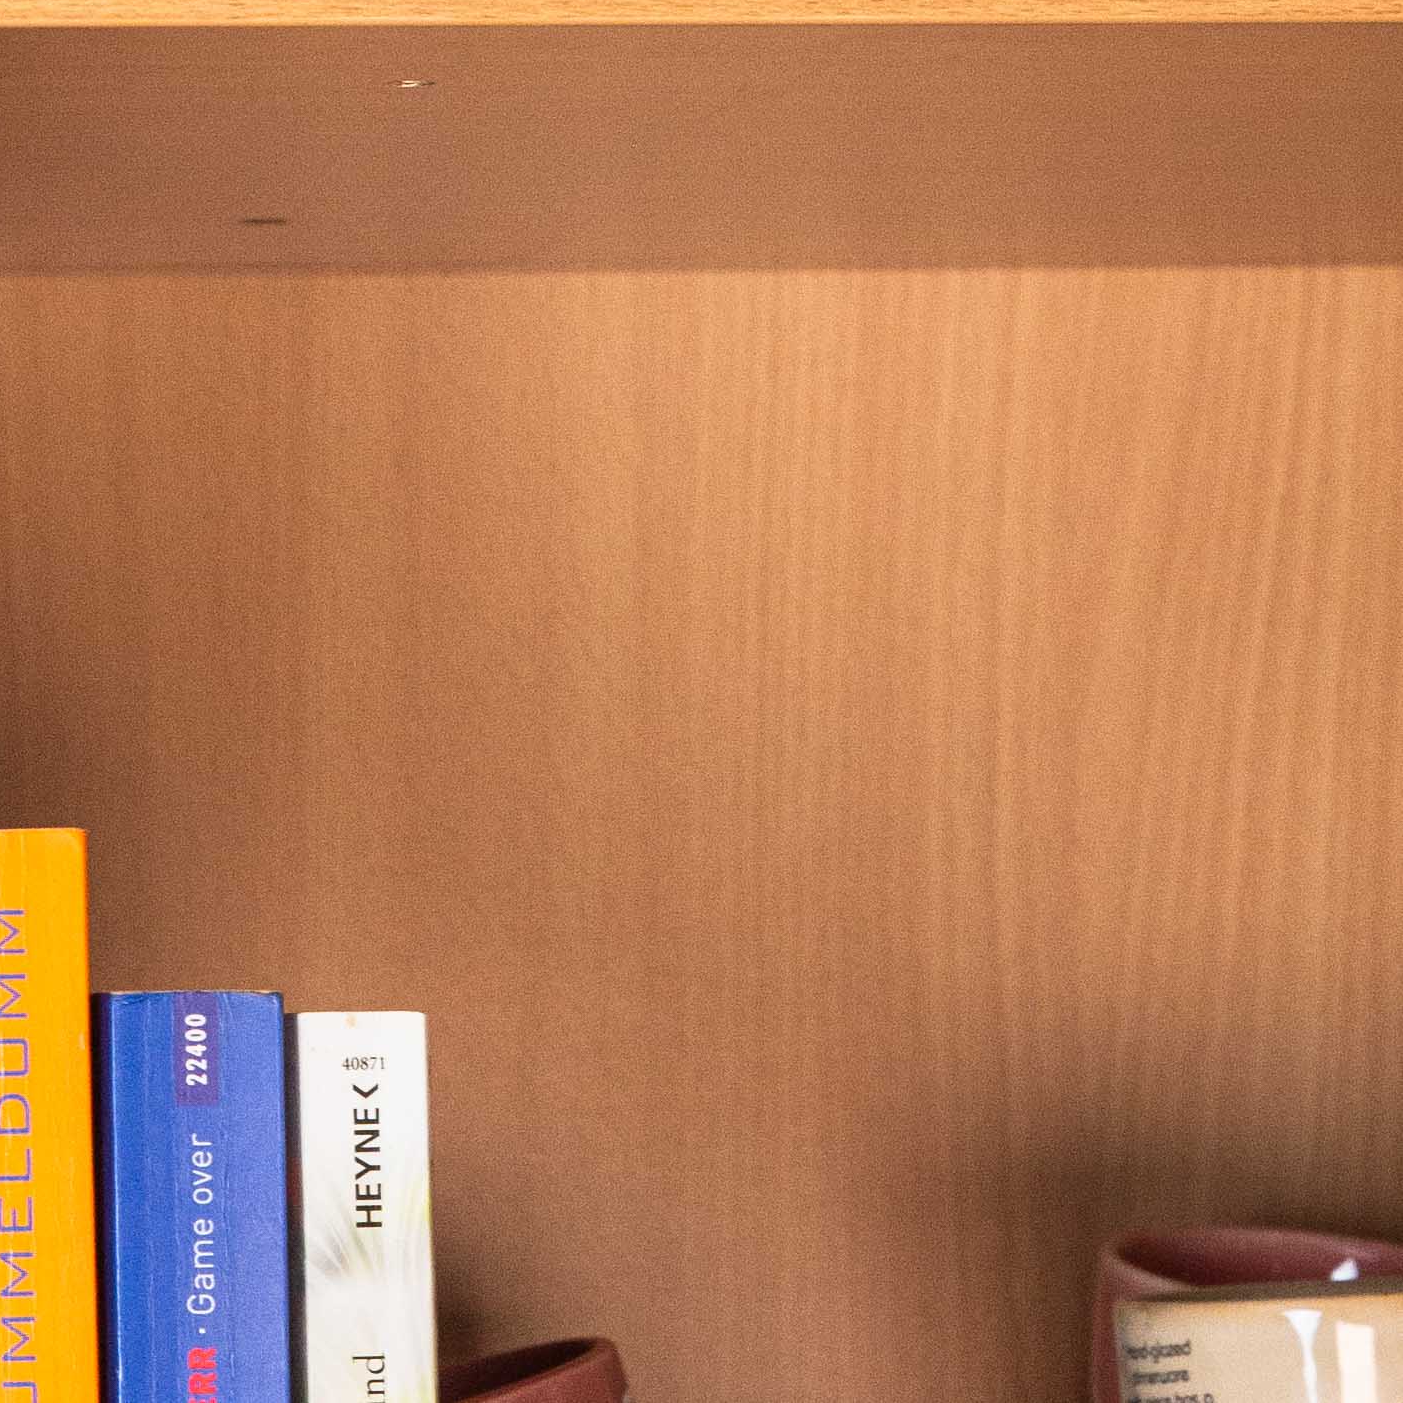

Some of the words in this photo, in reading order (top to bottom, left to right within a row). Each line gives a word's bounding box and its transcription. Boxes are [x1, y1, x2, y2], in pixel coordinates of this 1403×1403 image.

[184, 1013, 208, 1086] 22400
[342, 1056, 386, 1071] 40871
[191, 1133, 214, 1205] over
[352, 1107, 383, 1229] HEYNE
[186, 1218, 216, 1315] Game
[352, 1352, 386, 1403] nd
